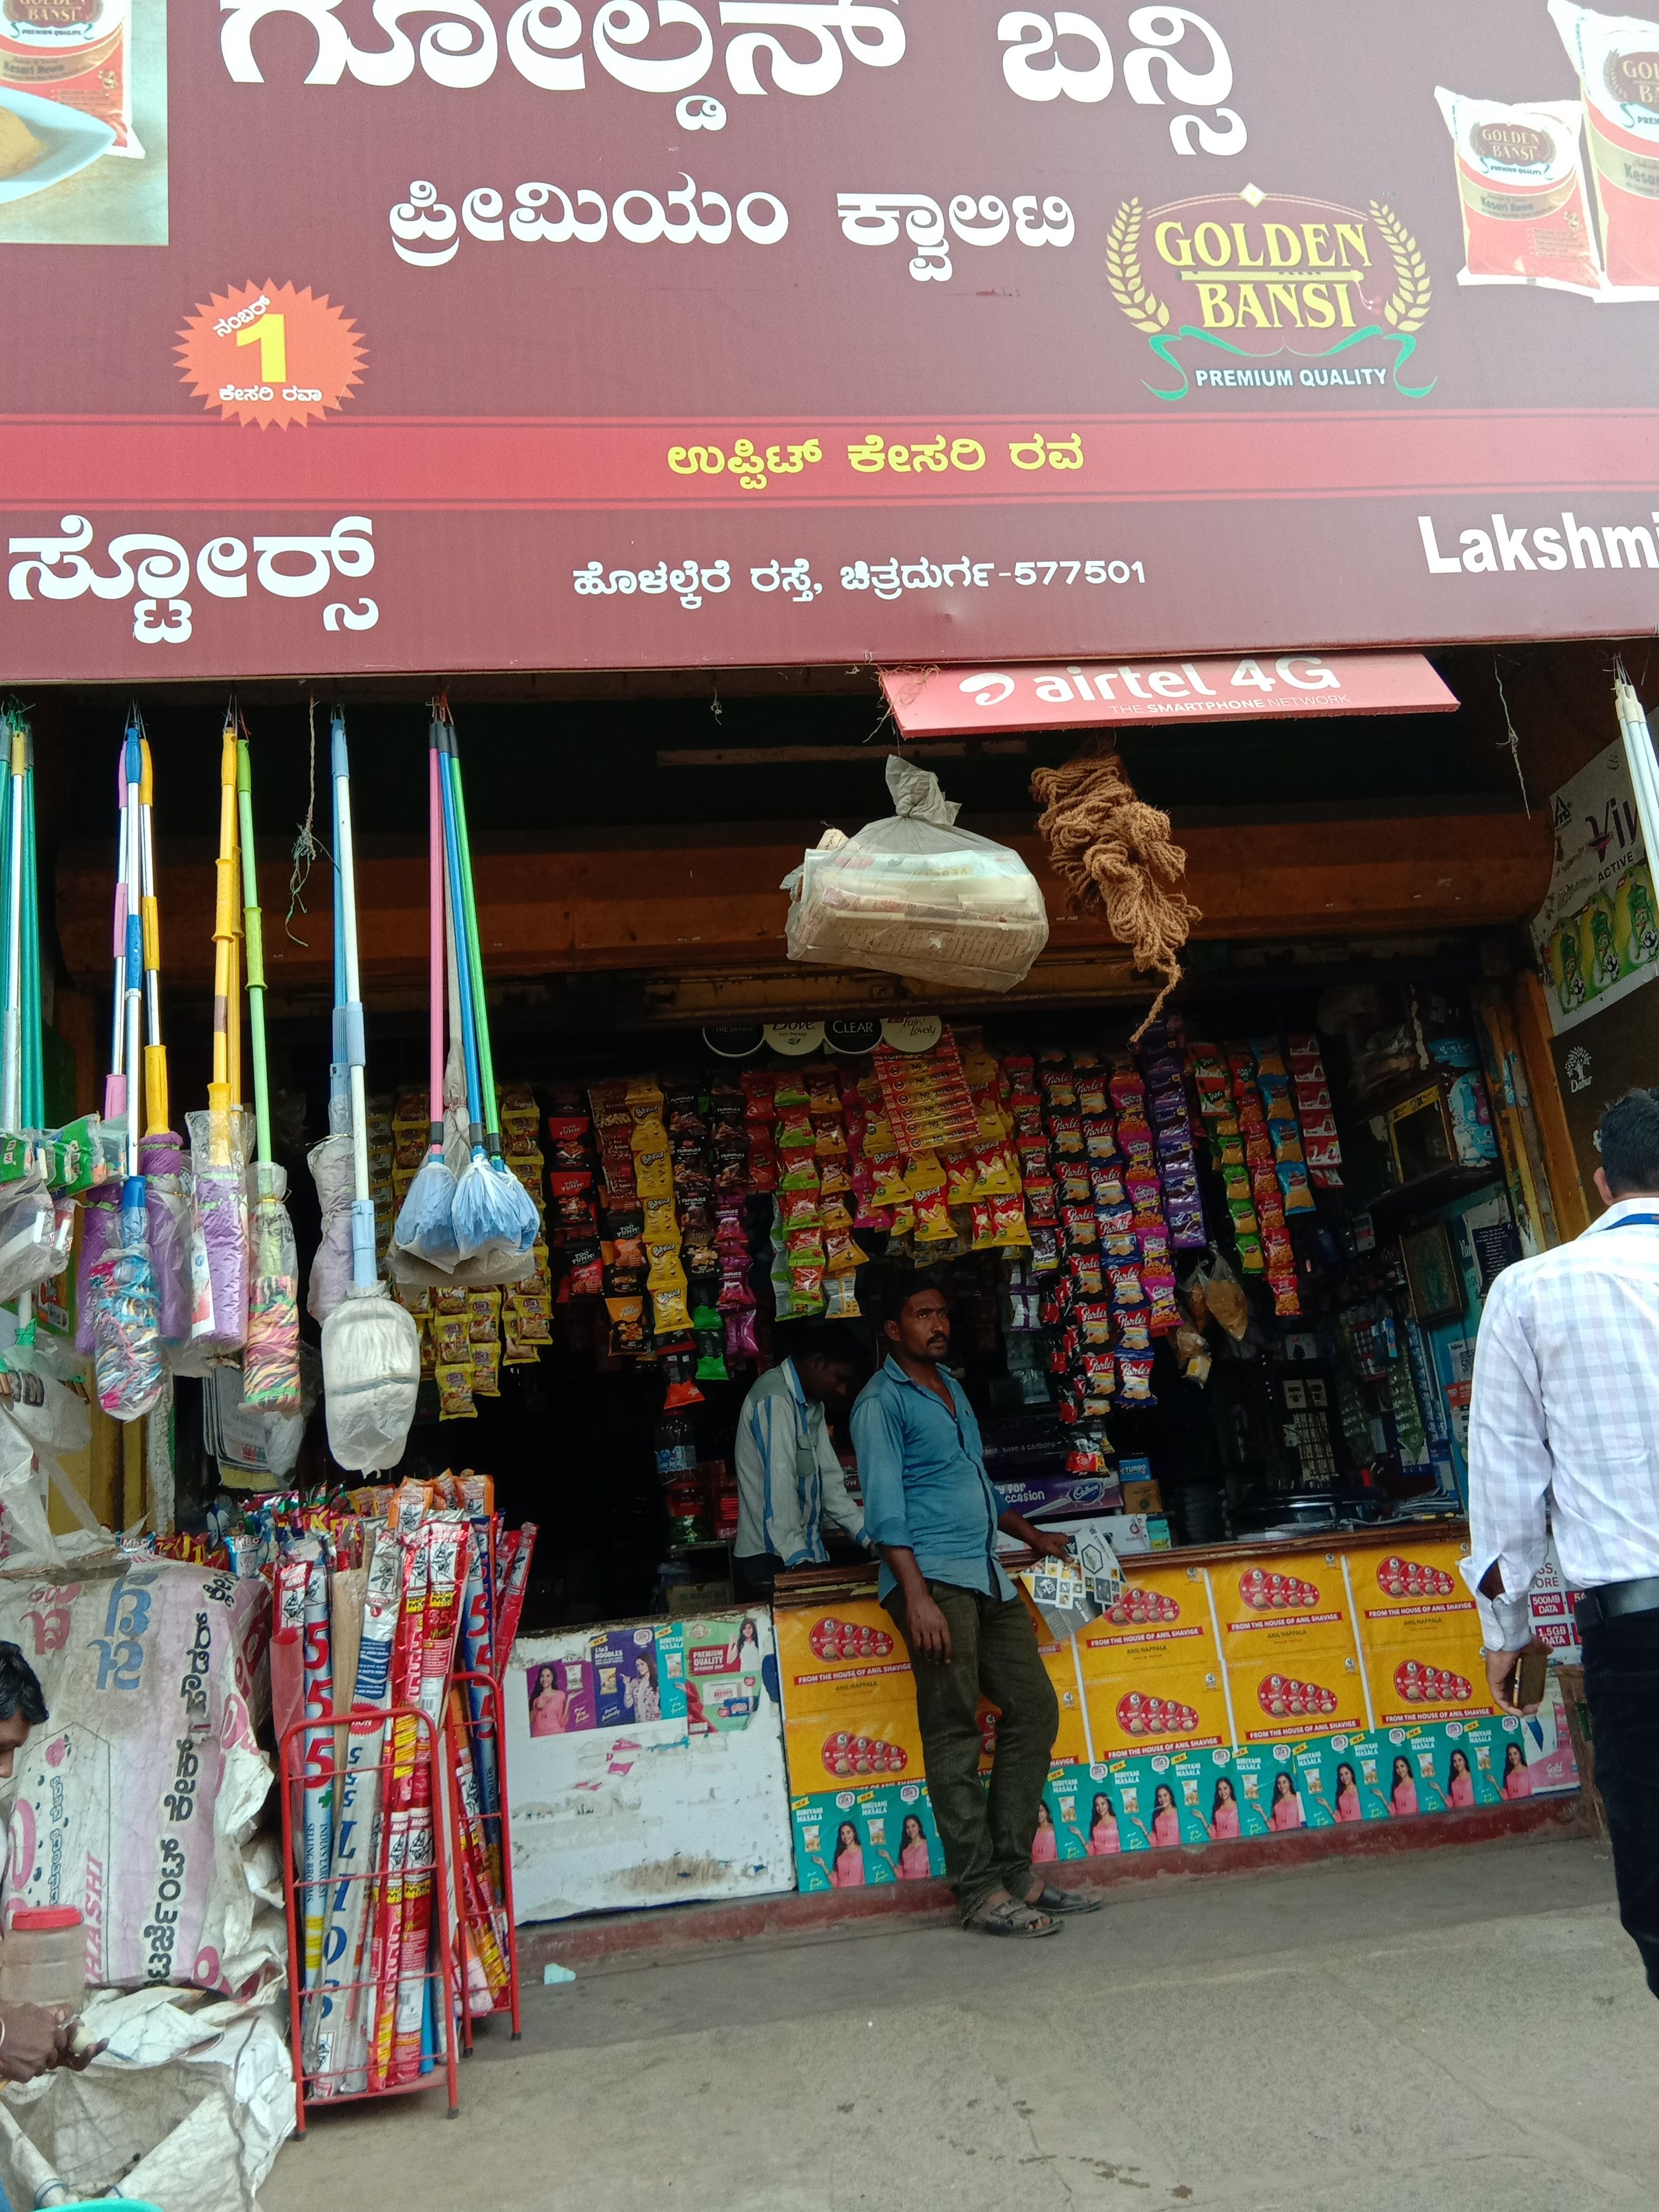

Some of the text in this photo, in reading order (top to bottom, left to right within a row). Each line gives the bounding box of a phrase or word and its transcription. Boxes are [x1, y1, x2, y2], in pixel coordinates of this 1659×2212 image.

[1482, 128, 1539, 143] GOLDEN
[1492, 145, 1534, 161] BANSI
[389, 172, 1076, 282] ಪ್ರೀಮಿಯಂ ಕ್ವಾಲಿಟಿ
[1154, 221, 1373, 268] GOLDEN
[1195, 283, 1357, 329] BANSI
[236, 313, 287, 383] 1
[1195, 368, 1388, 387] PREMIUM QUALITY
[219, 384, 323, 402] ಕೇಸರಿ ರವಾ
[667, 433, 1084, 490] ಉಪ್ಪಿಟ್ ಕೇಸರಿ ರವ
[1418, 511, 1659, 574] Lakshmi
[1035, 655, 1342, 703] airtel 4G
[1109, 693, 1351, 715] THE SMARTPHONE NETWORK
[1598, 851, 1634, 884] ACTIVE
[833, 1020, 873, 1034] CLEAR
[1538, 1604, 1558, 1614] DATA
[1231, 1622, 1249, 1630] FROM
[1264, 1619, 1285, 1627] HOUSE
[1091, 1638, 1109, 1646] FROM
[1124, 1634, 1145, 1643] HOUSE
[1542, 1635, 1565, 1646] DATA
[595, 1650, 623, 1659] NOODLES
[693, 1650, 723, 1659] PREMIUM
[694, 1656, 723, 1666] QUALITY
[798, 1675, 818, 1683] FROM
[833, 1670, 855, 1679] HOUSE
[1250, 1730, 1268, 1738] FROM
[1282, 1726, 1303, 1735] HOUSE
[1108, 1750, 1126, 1758] FROM
[1141, 1745, 1163, 1754] HOUSE
[1175, 1741, 1189, 1749] ANIL
[306, 1823, 315, 1860] SELLING
